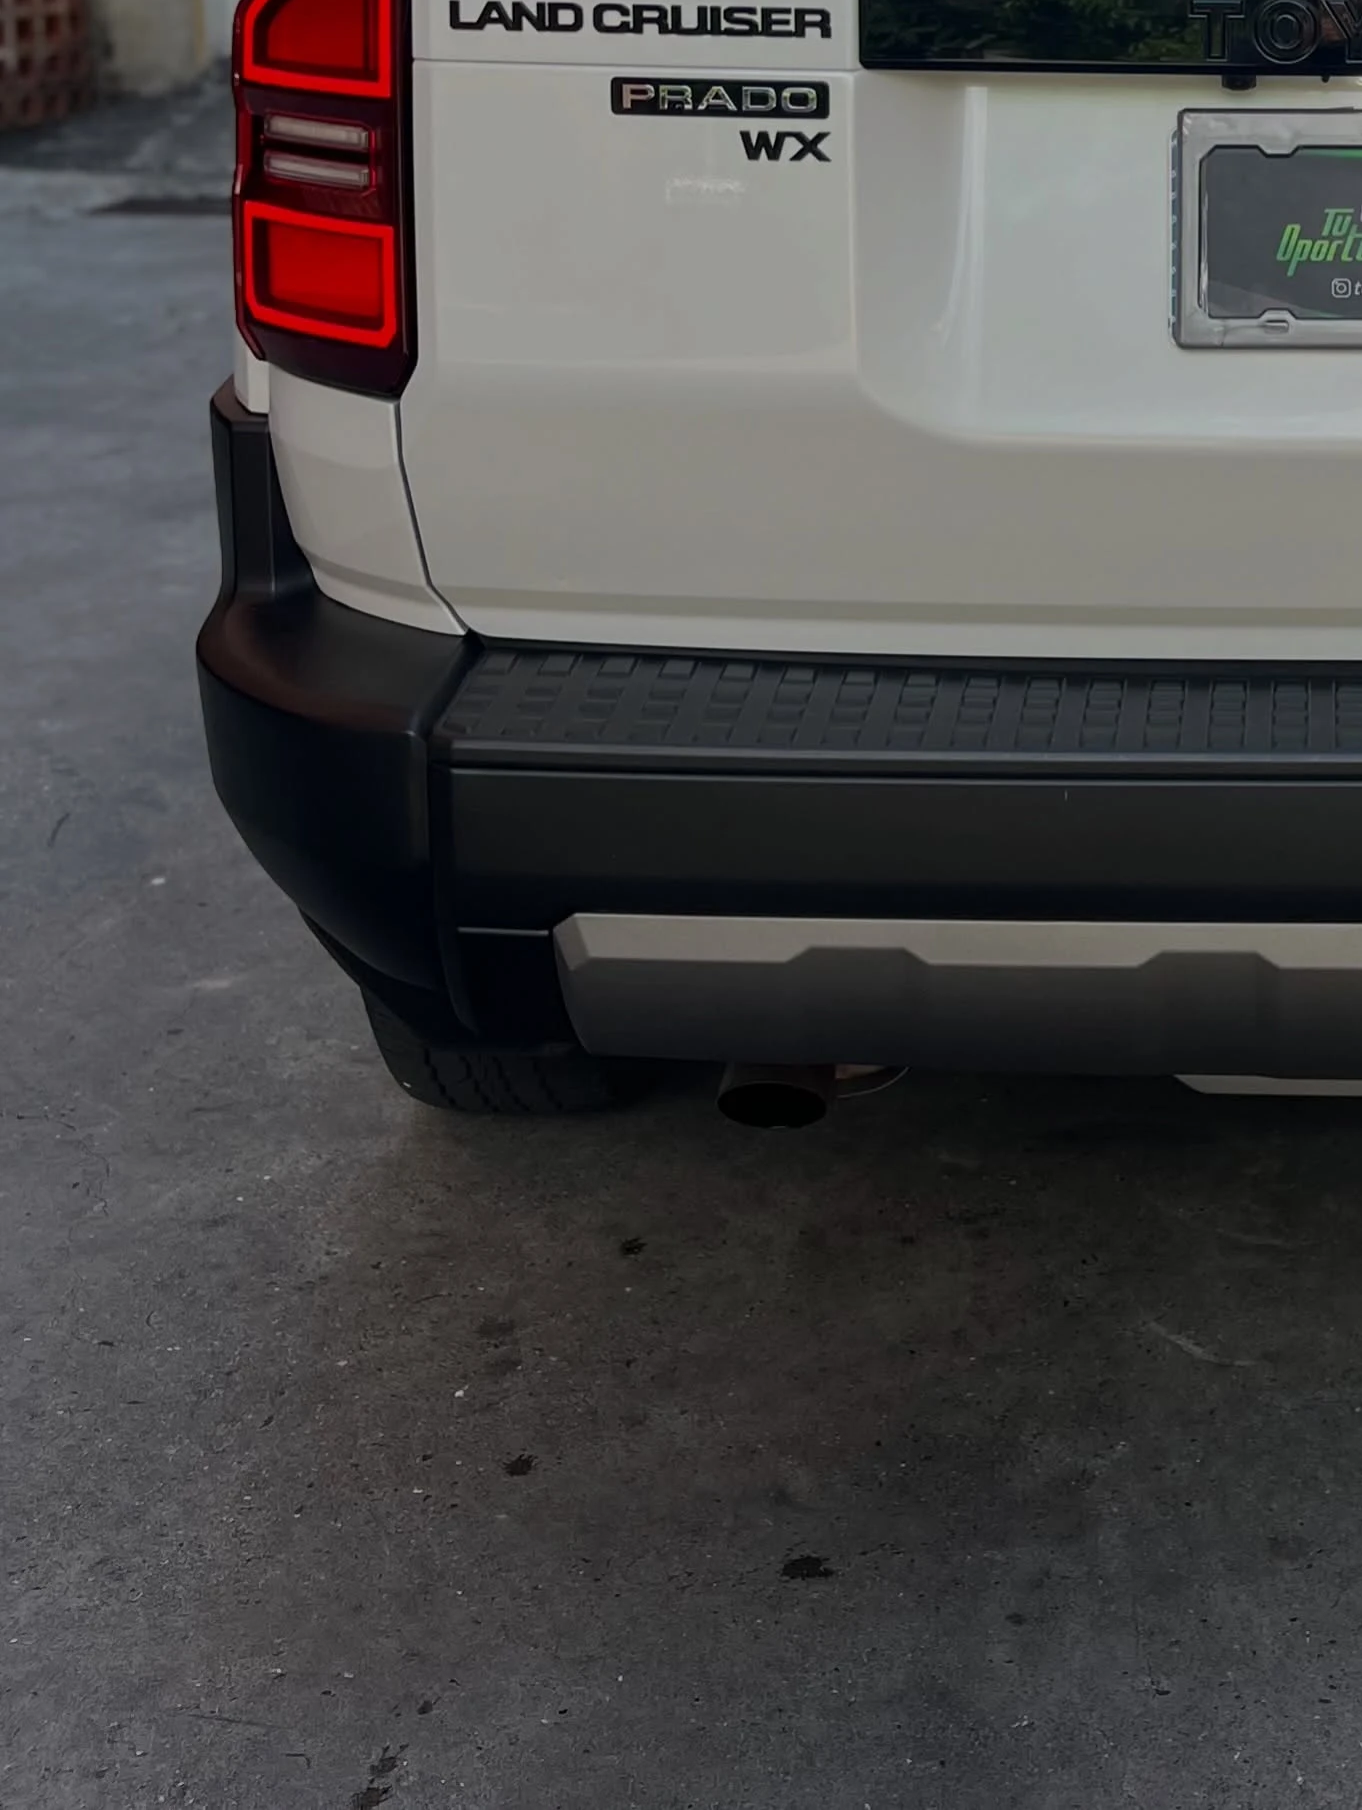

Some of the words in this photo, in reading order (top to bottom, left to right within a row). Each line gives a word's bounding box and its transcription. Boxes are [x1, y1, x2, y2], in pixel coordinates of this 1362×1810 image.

[449, 0, 583, 32] LAND
[593, 3, 832, 39] CRUISER
[621, 82, 819, 113] PRADO
[739, 130, 832, 162] WX
[1321, 208, 1355, 237] Tu
